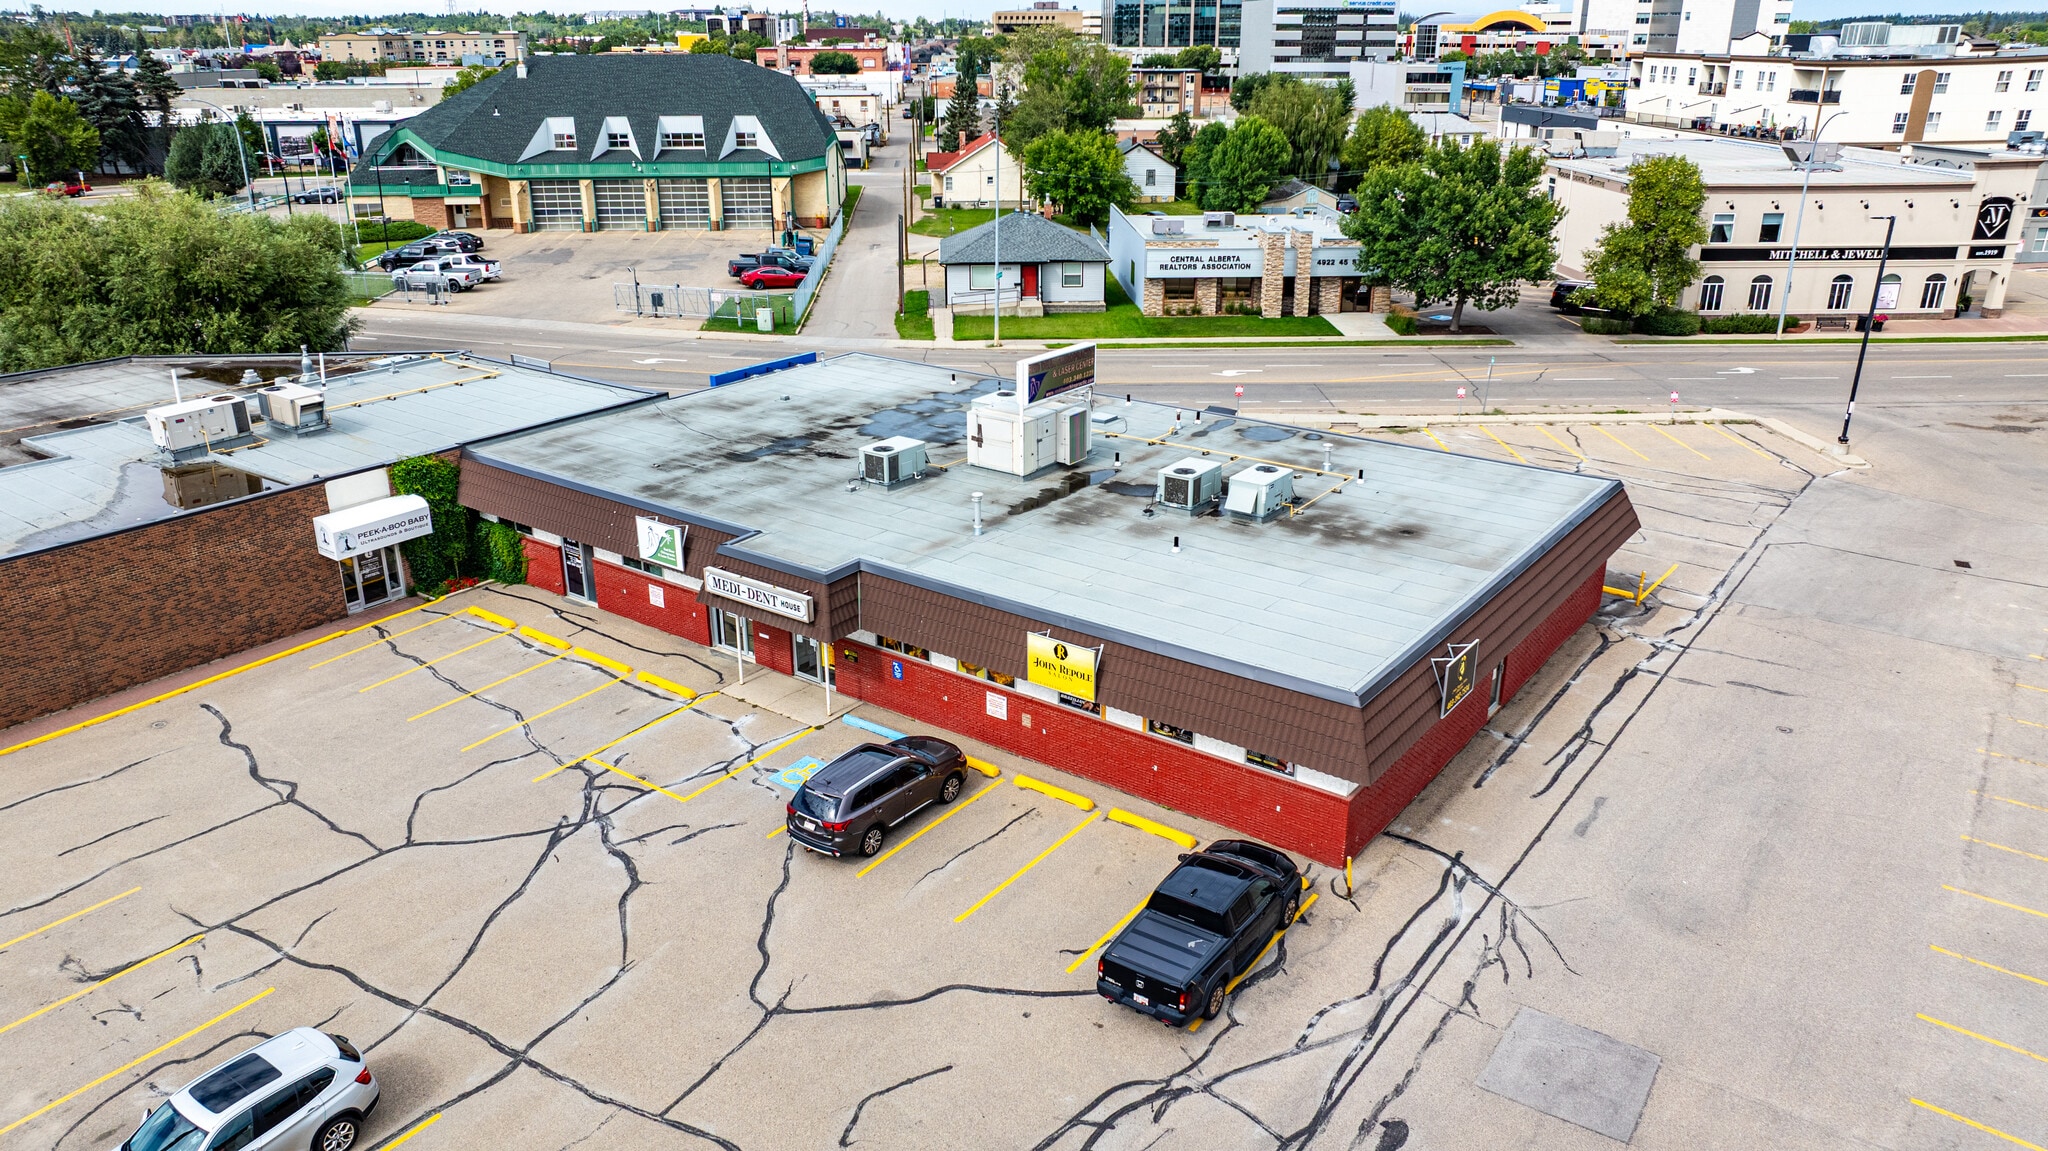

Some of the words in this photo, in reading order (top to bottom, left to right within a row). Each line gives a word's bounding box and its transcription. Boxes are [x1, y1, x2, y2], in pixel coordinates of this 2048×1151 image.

[1170, 255, 1205, 263] CENTRAL
[1208, 255, 1242, 263] ALBERTA
[1769, 250, 1830, 260] MITCHELL
[1830, 250, 1841, 259] &
[1159, 263, 1198, 271] REALTORS
[1316, 258, 1336, 266] 4922
[1058, 364, 1076, 377] LASER
[407, 513, 429, 526] BABY
[712, 576, 778, 607] MEDI-DENT
[780, 600, 801, 613] HOUSE
[1033, 657, 1057, 672] JOHN
[1059, 664, 1093, 683] REPOLE
